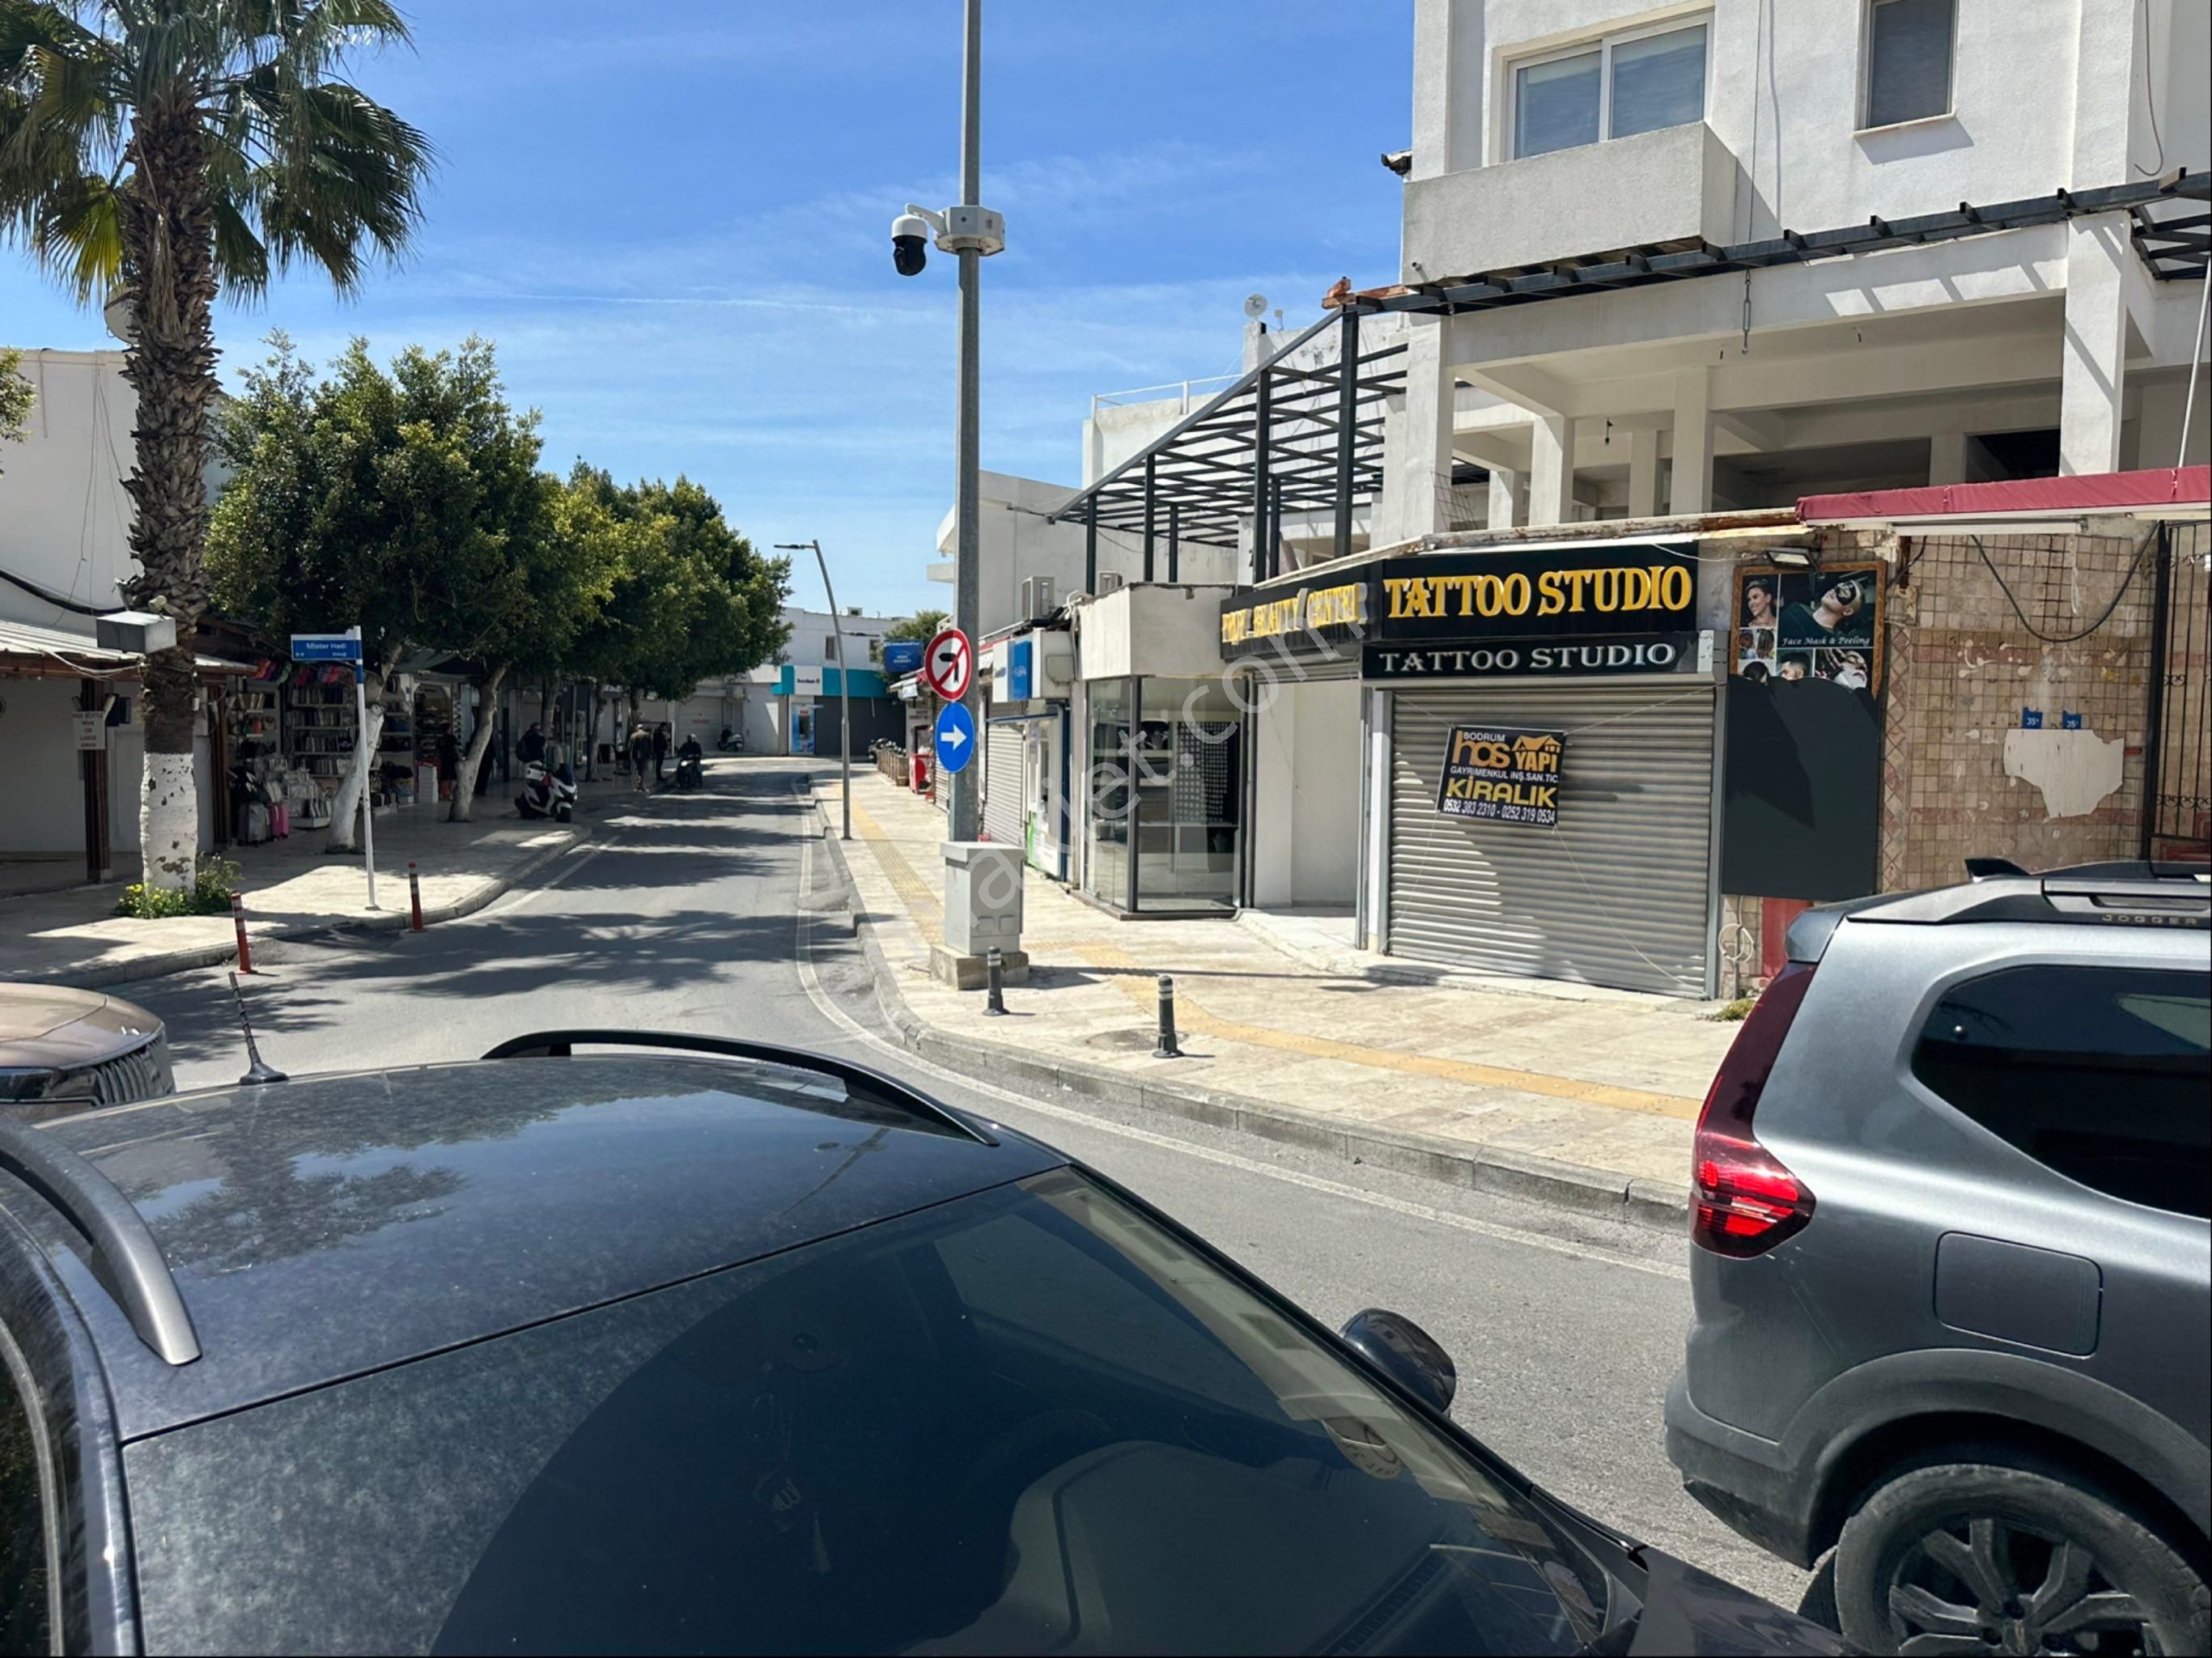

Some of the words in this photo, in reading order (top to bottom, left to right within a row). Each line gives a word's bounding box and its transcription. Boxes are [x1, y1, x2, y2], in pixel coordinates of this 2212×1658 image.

[1382, 573, 1531, 618] TATTOO
[1537, 566, 1692, 617] STUDIO
[1781, 637, 1802, 647] Face
[1803, 636, 1828, 645] Mask
[1838, 635, 1870, 647] Peeling
[1378, 650, 1520, 672] TATTOO
[1529, 643, 1676, 669] STUDIO
[1463, 731, 1505, 742] BODRUM
[1514, 751, 1557, 773] YAPI
[1476, 802, 1497, 817] 2310
[1501, 804, 1521, 820] 0252
[1521, 806, 1536, 822] 319
[1536, 808, 1556, 824] 0534
[2102, 914, 2197, 925] JOGGER
